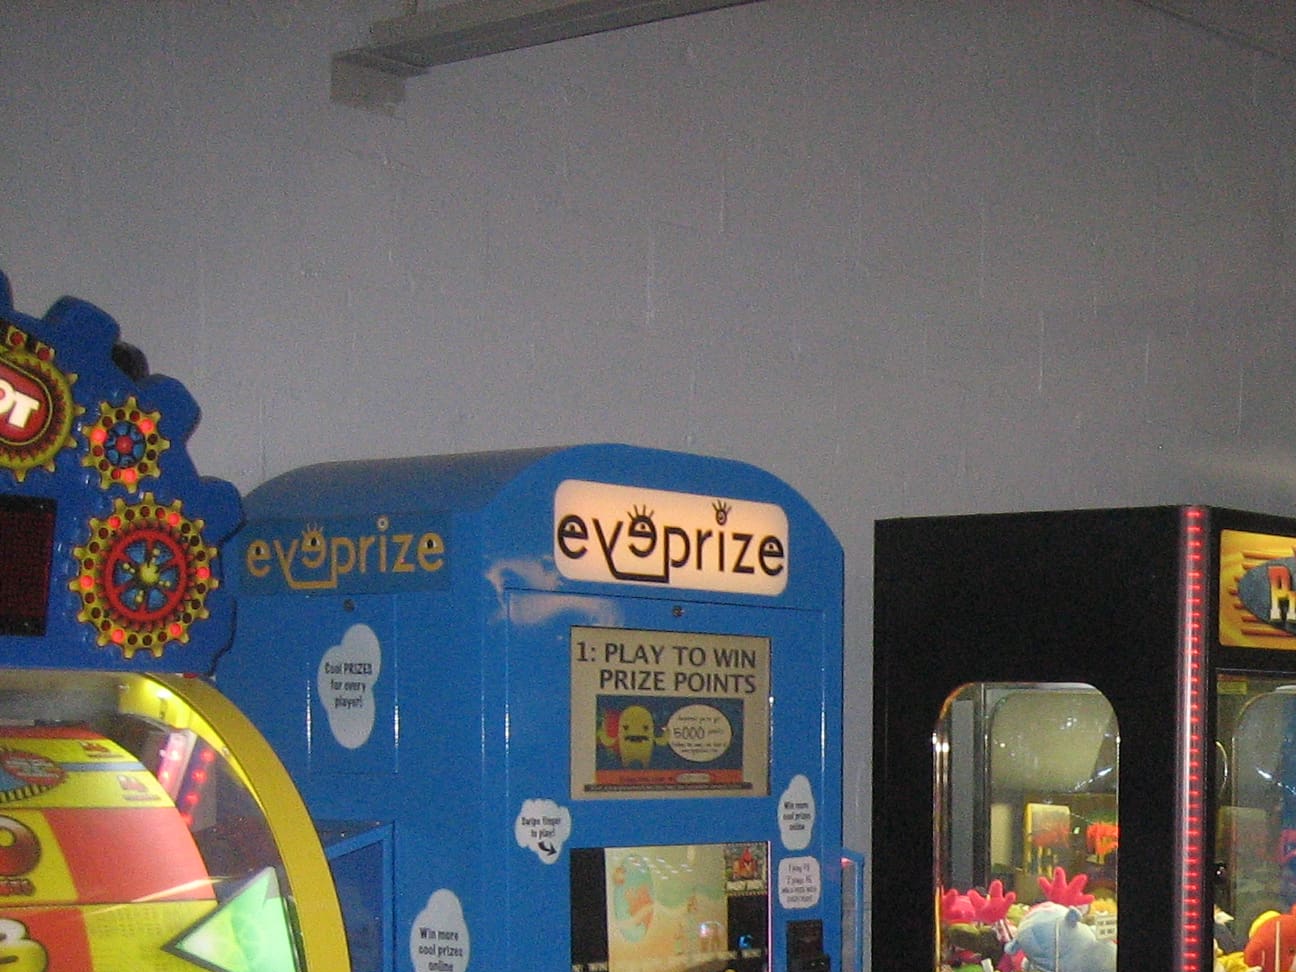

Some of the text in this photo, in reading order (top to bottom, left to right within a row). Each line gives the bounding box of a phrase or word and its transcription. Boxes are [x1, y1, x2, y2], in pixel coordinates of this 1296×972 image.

[577, 641, 756, 669] 1: PLAY TO WIN
[600, 669, 757, 694] PRIZE POINTS
[420, 928, 459, 941] Win more
[418, 944, 463, 958] cool prizes
